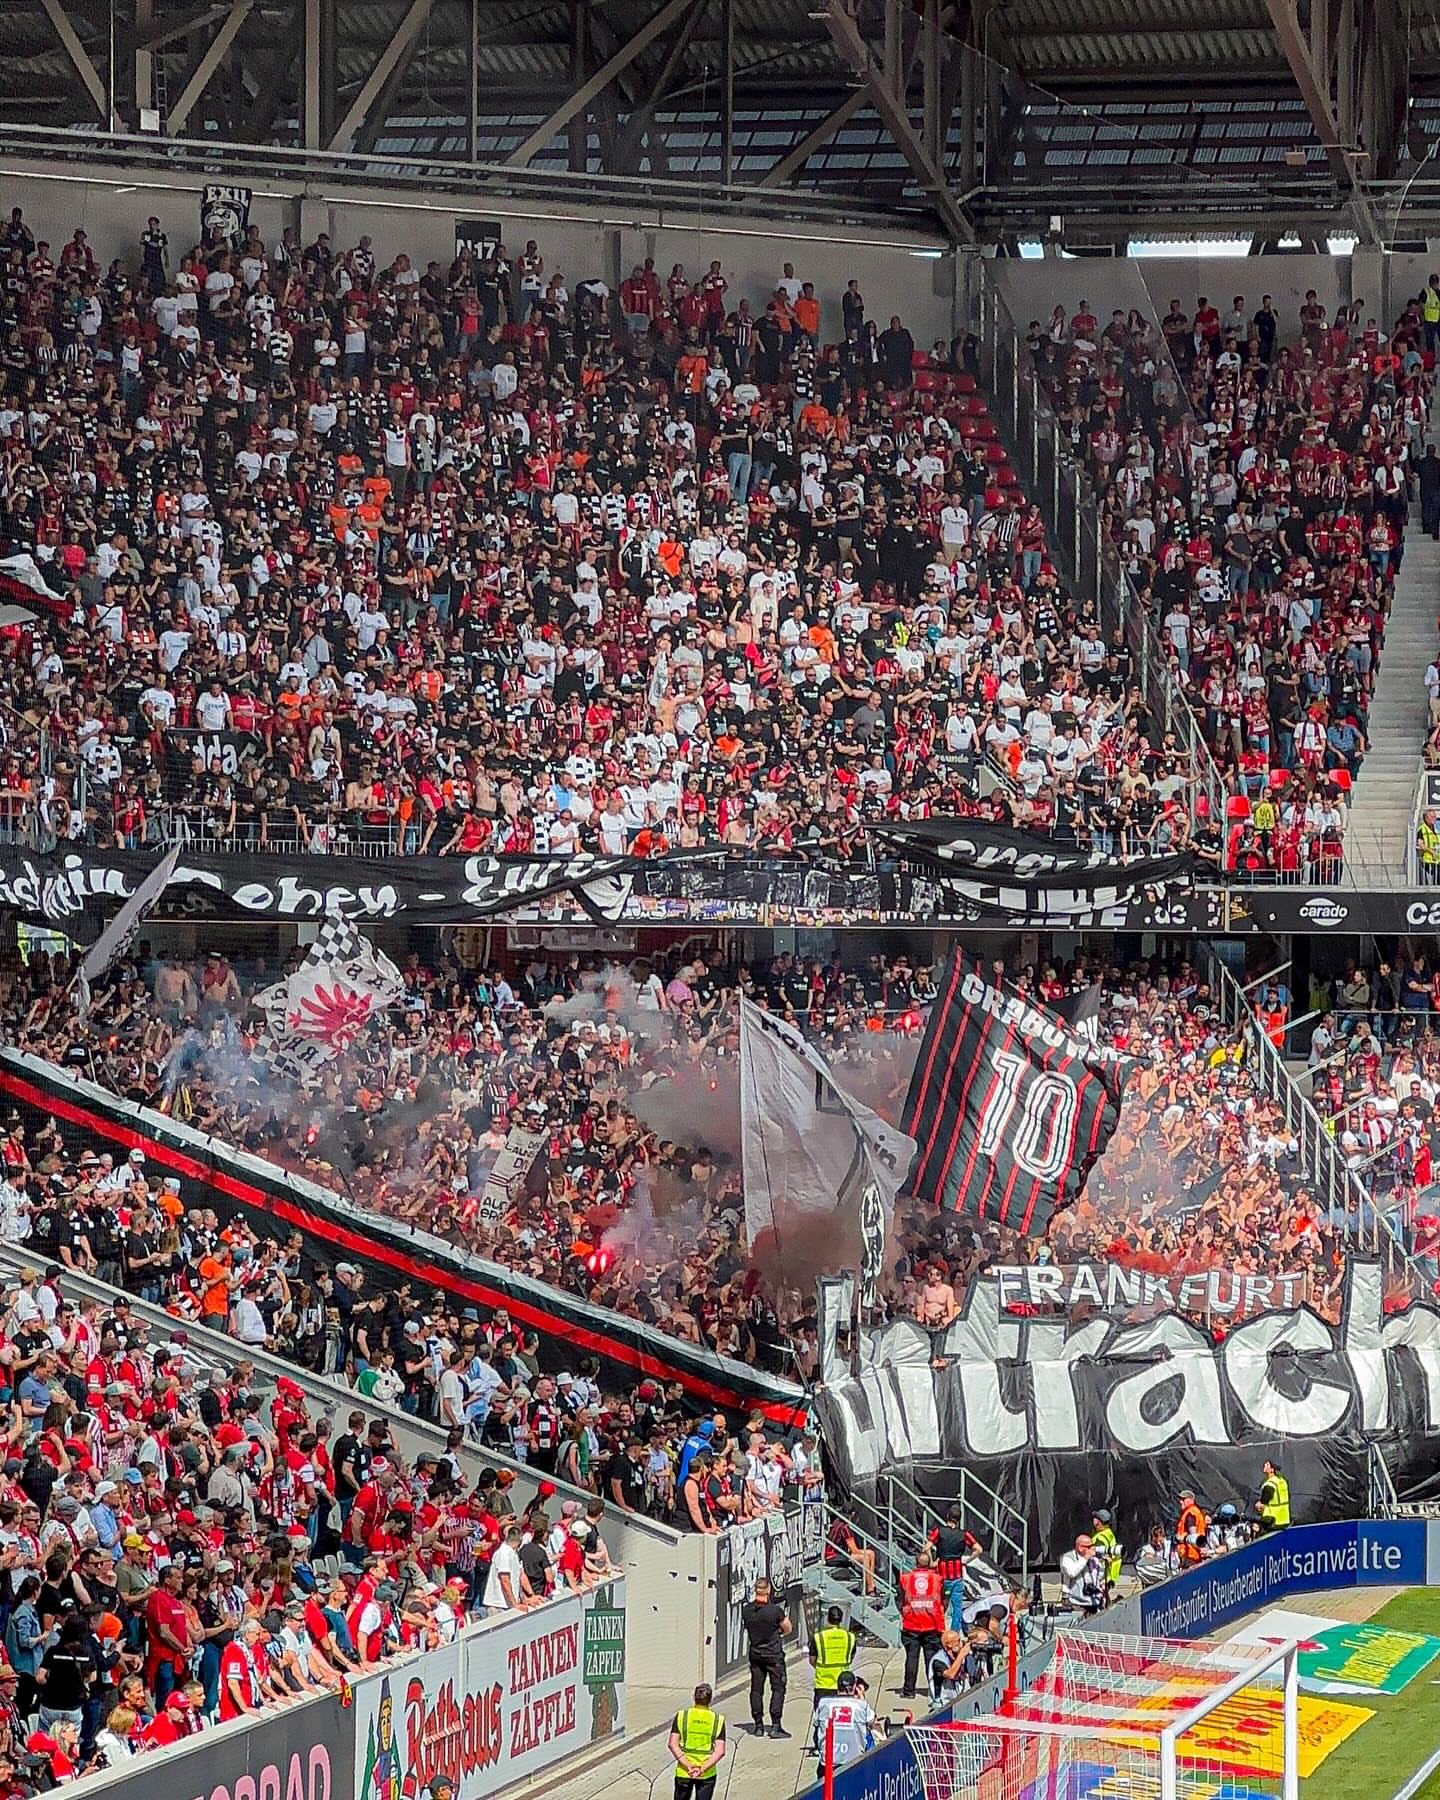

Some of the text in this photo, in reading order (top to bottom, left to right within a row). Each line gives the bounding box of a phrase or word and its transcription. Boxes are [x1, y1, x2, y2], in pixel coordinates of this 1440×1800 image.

[1299, 904, 1349, 919] carado
[977, 1046, 1078, 1184] 10
[992, 1263, 1306, 1314] FRANKFURT
[1212, 1564, 1264, 1613] Steuerberater
[1269, 1537, 1402, 1586] Rechtsanwälte
[507, 1622, 580, 1697] TANNEN
[586, 1614, 625, 1642] TANNEN
[586, 1645, 624, 1677] ZÄPFLE
[404, 1677, 504, 1798] Rothaus
[509, 1684, 577, 1759] ZÄPFLE
